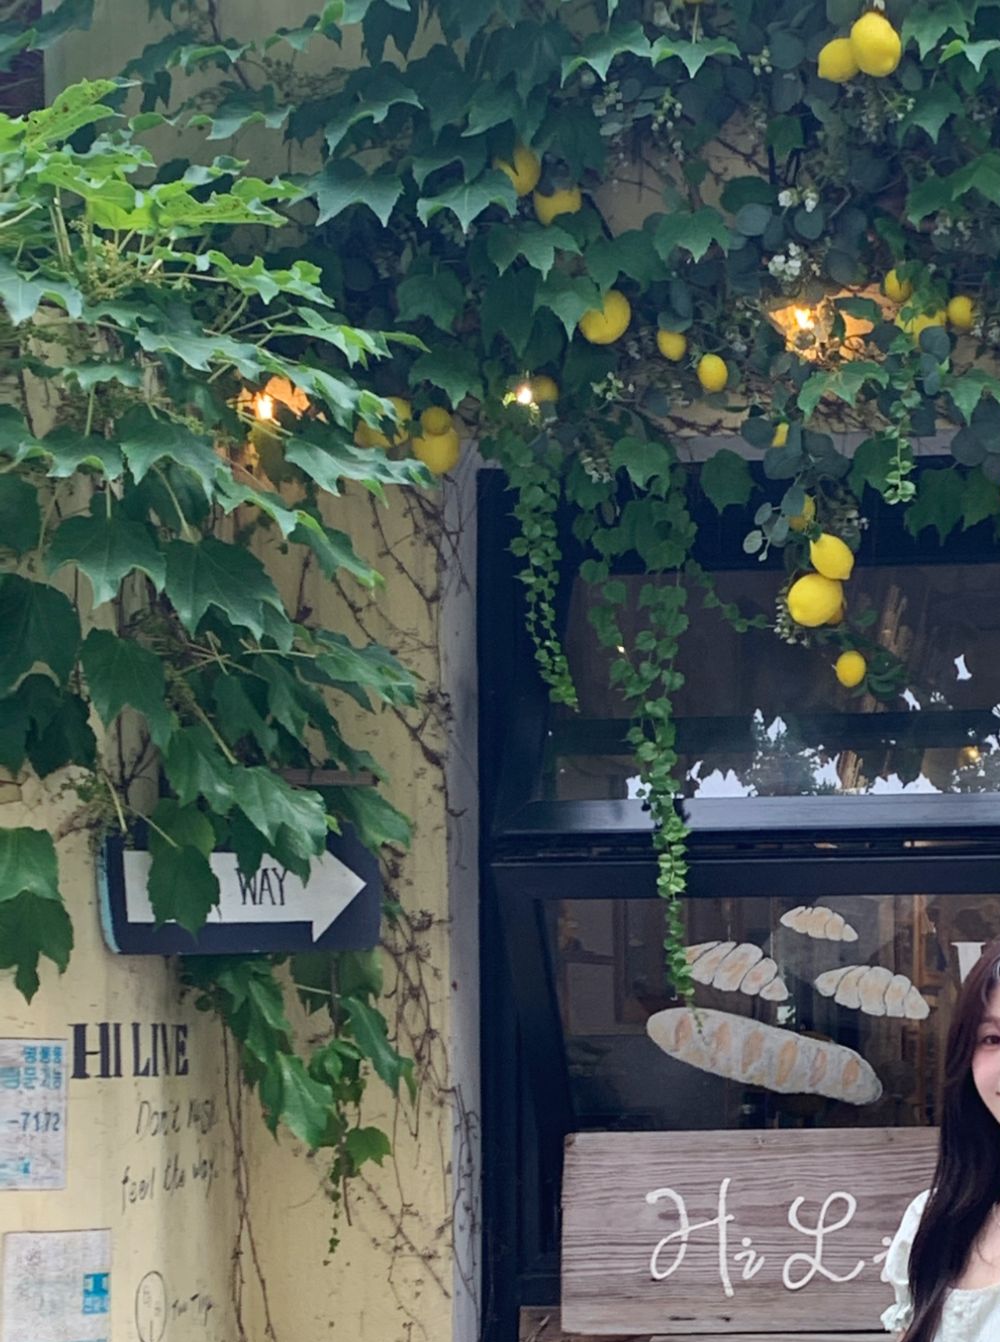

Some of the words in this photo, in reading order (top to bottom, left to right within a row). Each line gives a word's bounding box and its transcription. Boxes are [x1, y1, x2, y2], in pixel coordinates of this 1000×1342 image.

[235, 866, 288, 906] WAY
[67, 1022, 123, 1078] HI
[132, 1022, 189, 1077] LIVE
[646, 1178, 765, 1298] Hi
